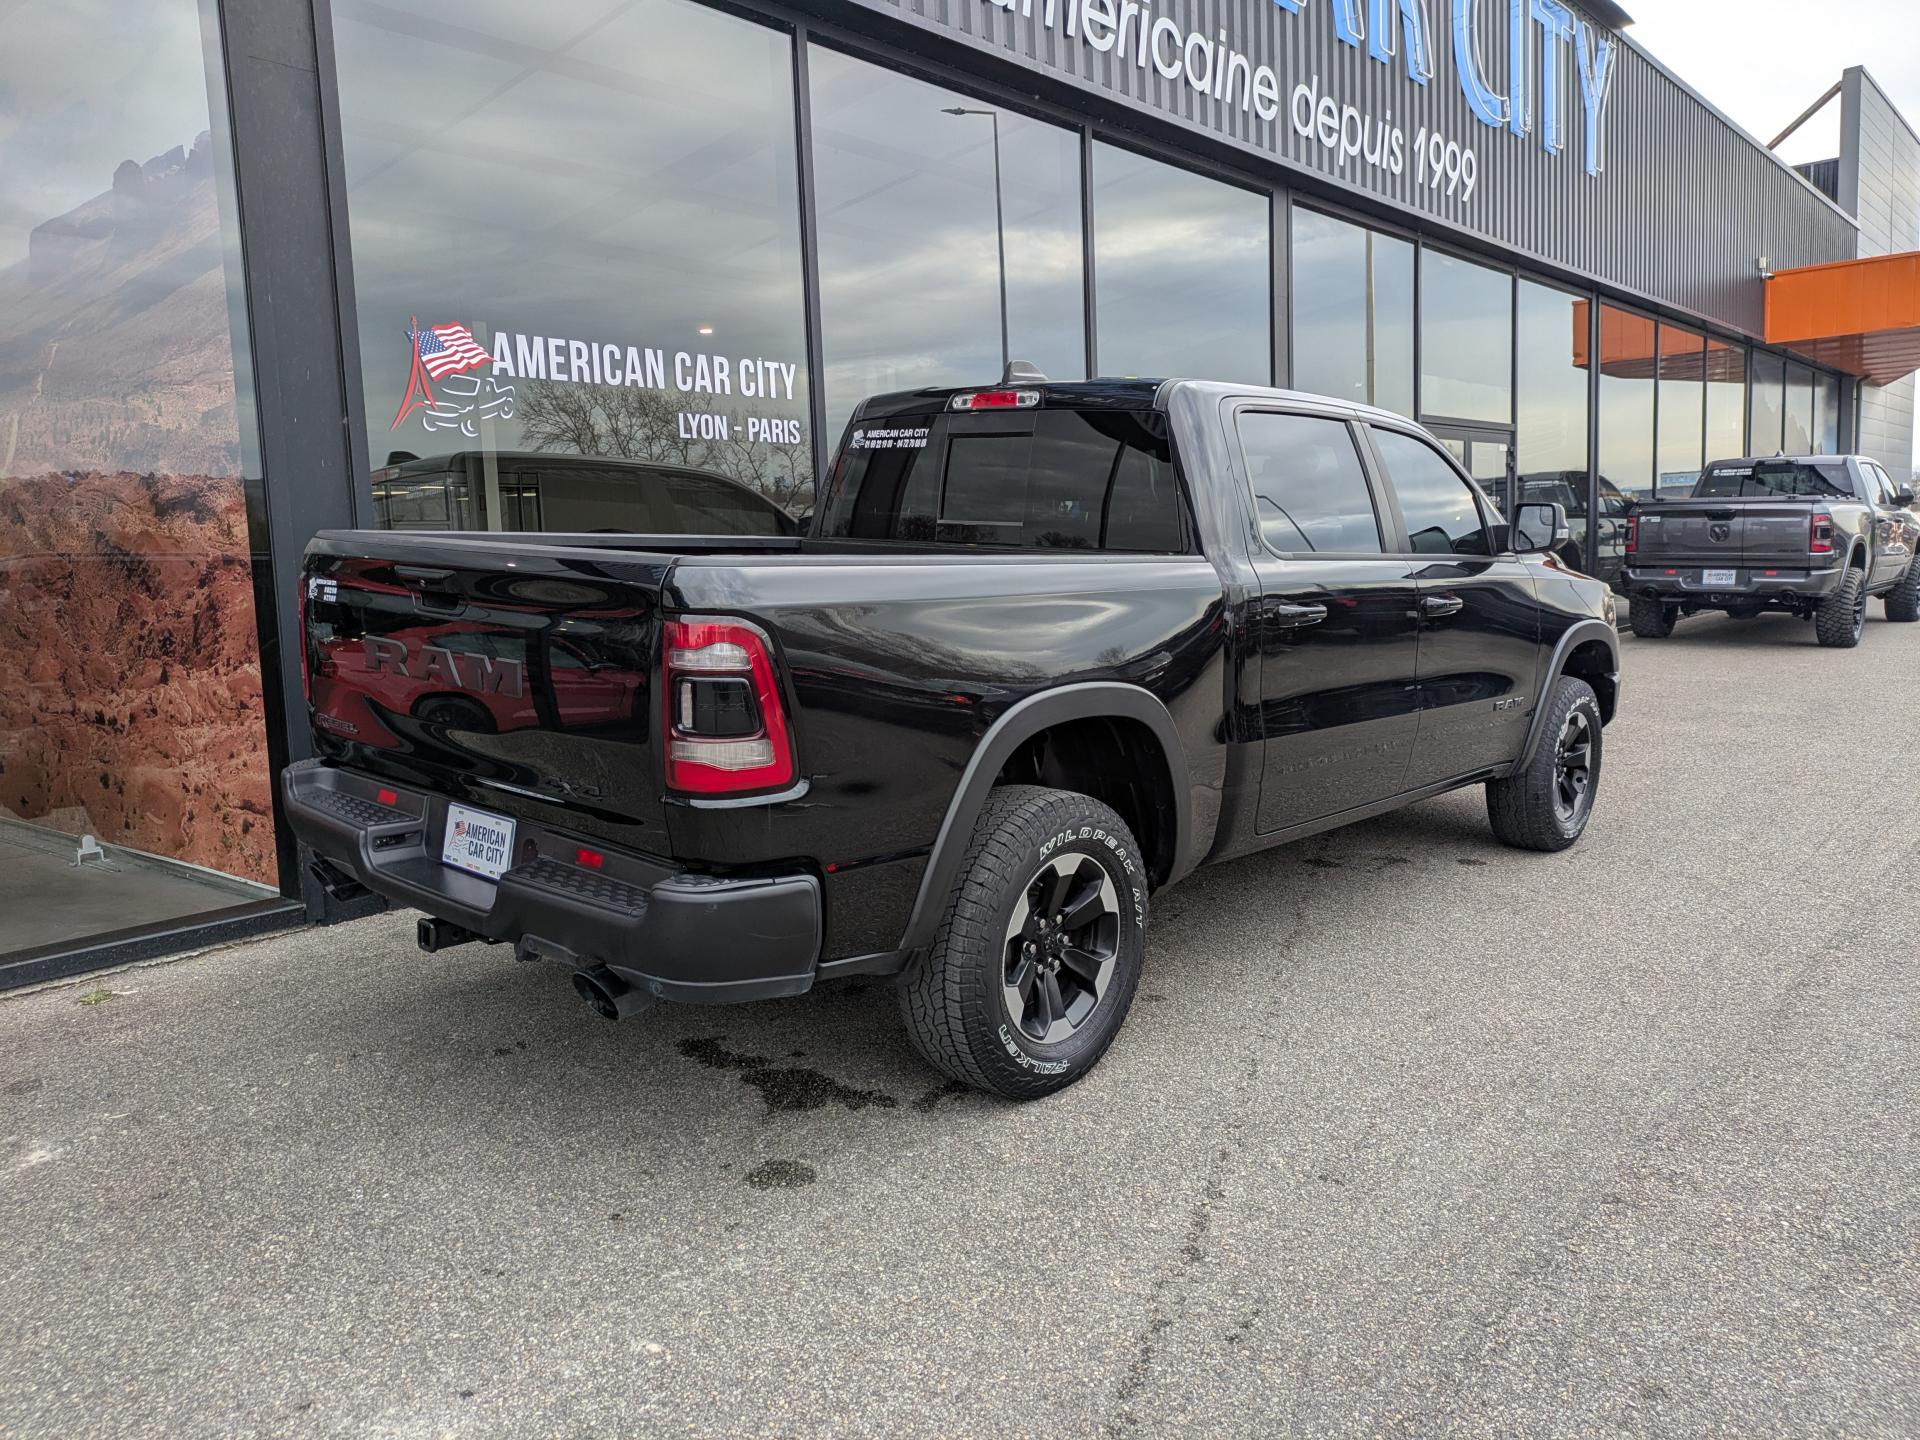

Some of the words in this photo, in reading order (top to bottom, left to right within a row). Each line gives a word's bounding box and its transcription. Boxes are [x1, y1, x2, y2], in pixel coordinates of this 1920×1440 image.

[1291, 75, 1404, 175] depuis
[1413, 126, 1477, 202] 1999
[492, 331, 665, 389] AMERICAN
[674, 351, 731, 395] CAR
[678, 412, 728, 441] LYON
[747, 417, 800, 444] PARIS
[866, 430, 899, 438] AMERICAN
[900, 429, 914, 437] CAR
[914, 428, 929, 437] CITY
[365, 635, 524, 698] RAM
[465, 822, 506, 848] AMERICAN
[468, 840, 484, 860] CAR
[485, 845, 504, 866] CITY
[1040, 827, 1135, 875] WILDPEAK
[998, 1024, 1071, 1075] FALKEN
